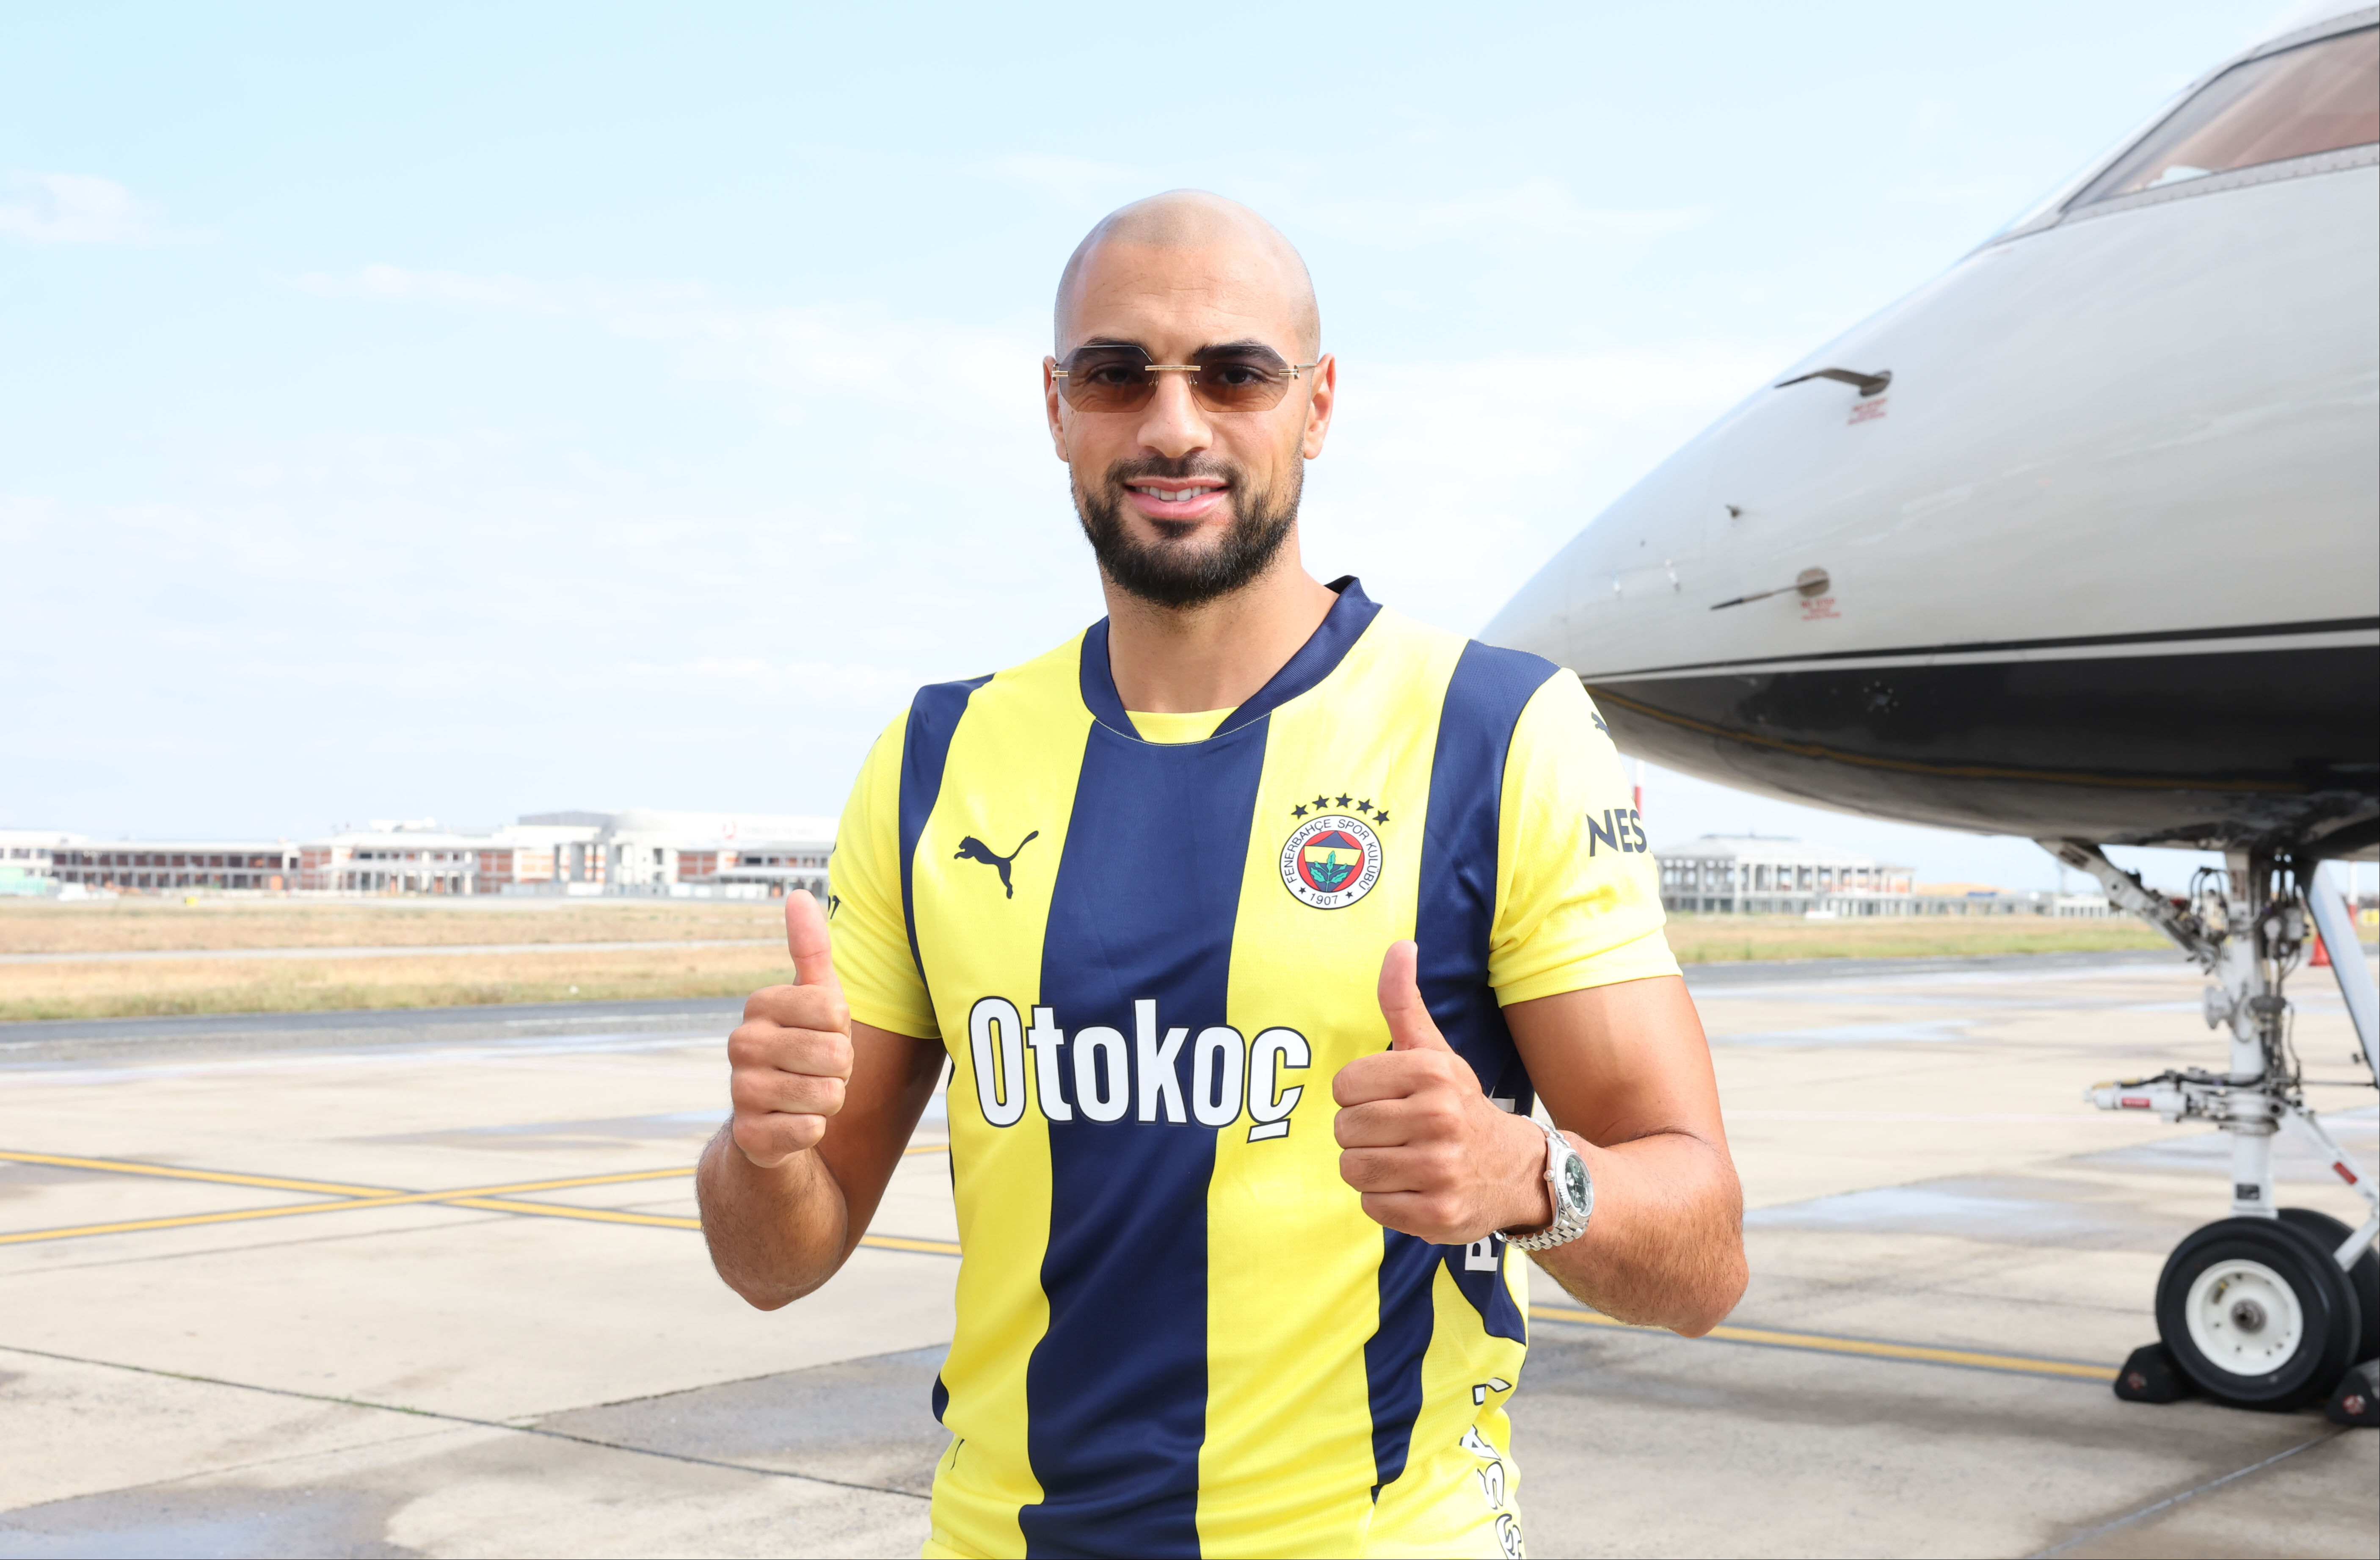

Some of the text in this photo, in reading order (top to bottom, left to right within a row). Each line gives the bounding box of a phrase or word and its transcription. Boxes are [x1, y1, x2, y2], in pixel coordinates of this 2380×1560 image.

[1284, 819, 1379, 890] FENERBAHÇE SPOR KULÜBÜ
[1586, 809, 1651, 857] NES
[1310, 893, 1339, 906] 1907
[968, 995, 1311, 1143] Otokoç
